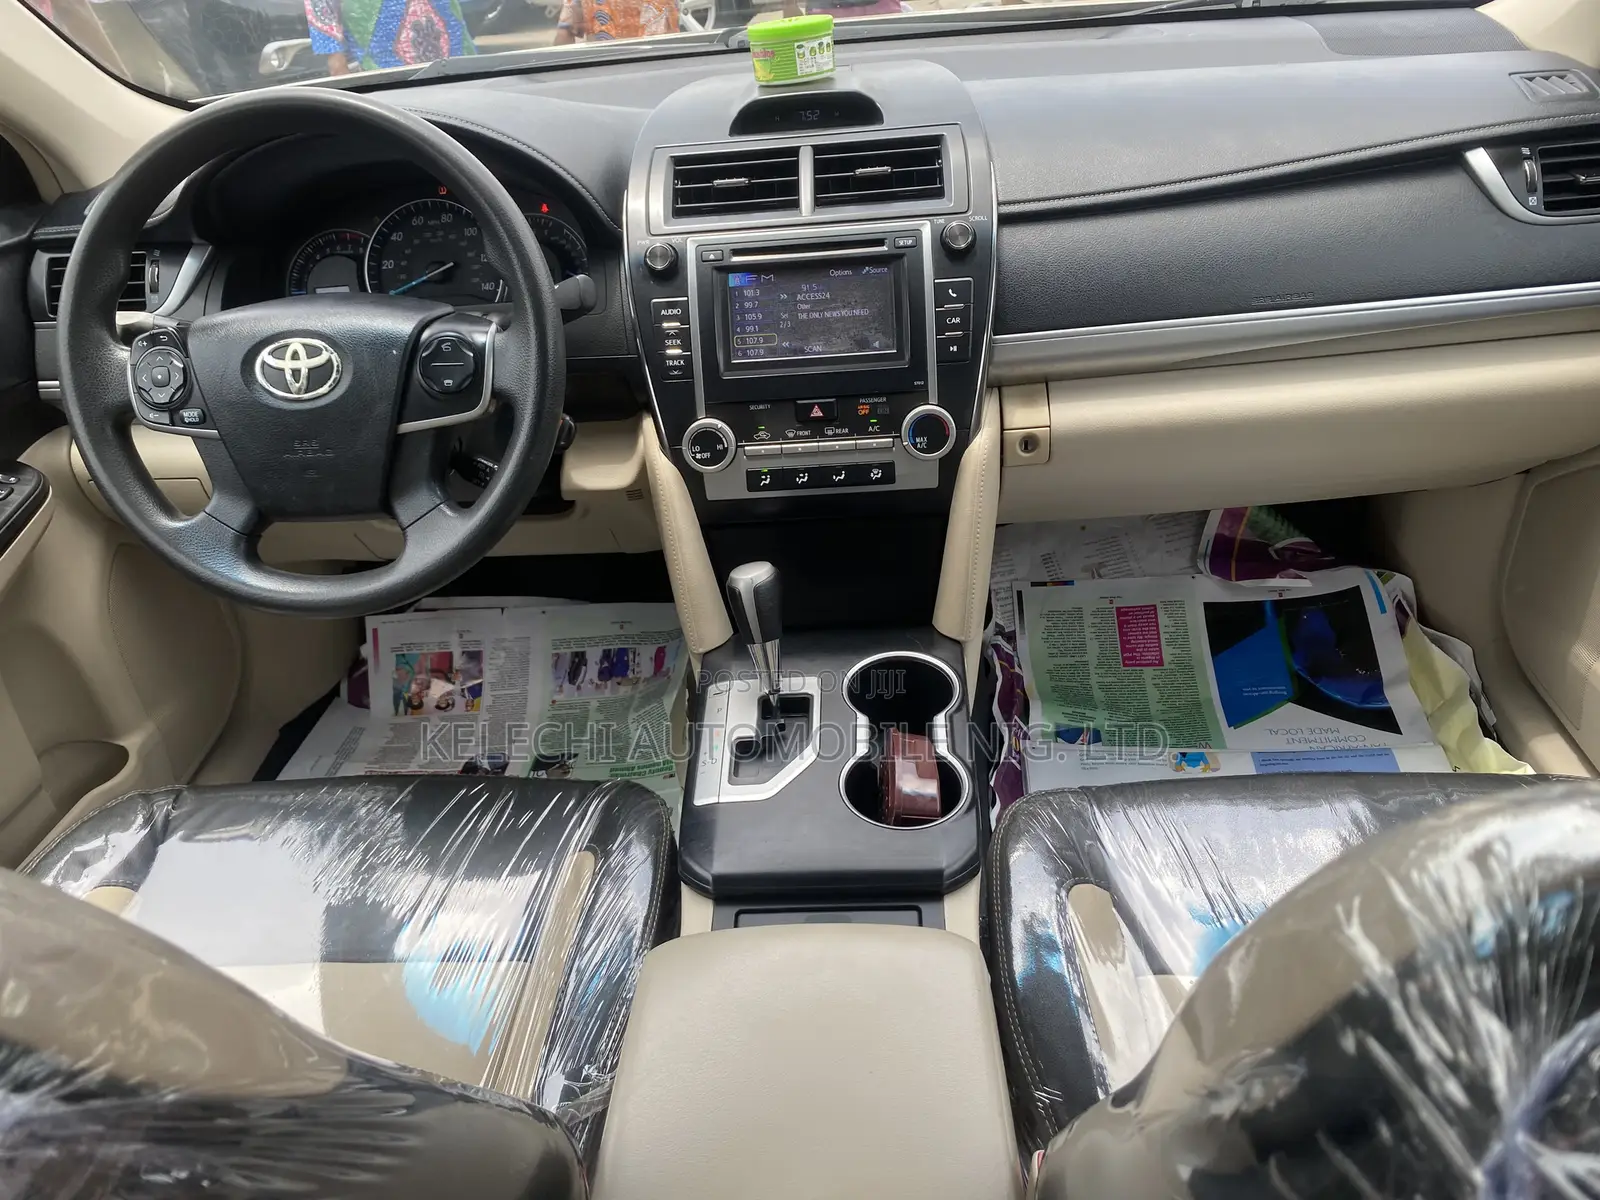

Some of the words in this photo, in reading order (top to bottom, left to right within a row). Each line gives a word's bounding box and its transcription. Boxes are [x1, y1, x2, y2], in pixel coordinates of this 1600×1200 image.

[411, 216, 424, 226] 60
[440, 213, 453, 223] 80
[464, 227, 477, 237] 100
[390, 232, 404, 242] 40
[898, 238, 914, 247] SETUP
[382, 260, 395, 270] 20
[829, 269, 853, 278] Options
[868, 266, 888, 275] Source
[481, 282, 496, 292] 140
[743, 289, 760, 297] 101.3
[796, 292, 830, 301] ACCESS24
[744, 301, 759, 309] 99.7
[660, 308, 682, 316] AUDIO
[797, 311, 809, 320] THE
[809, 311, 824, 319] ONLY
[824, 310, 841, 318] NEWS
[840, 309, 853, 317] YOU
[852, 308, 869, 316] NEED
[744, 313, 763, 321] 105.9
[946, 316, 961, 325] CAR
[745, 325, 759, 333] 99.1
[779, 321, 791, 329] 2/3
[664, 338, 682, 347] SEEK
[746, 337, 764, 345] 107.9
[746, 349, 765, 357] 107.9
[804, 345, 823, 353] SCAN
[665, 358, 685, 367] TRACK
[859, 396, 887, 404] PASSENGER
[748, 403, 771, 411] SECURITY
[796, 429, 812, 437] FRONT
[835, 427, 849, 435] REAR
[915, 437, 928, 445] MAX
[691, 445, 701, 453] LO
[1263, 727, 1304, 736] LOCAL
[1305, 727, 1340, 736] MADE
[1285, 734, 1367, 745] COMMITMENT
